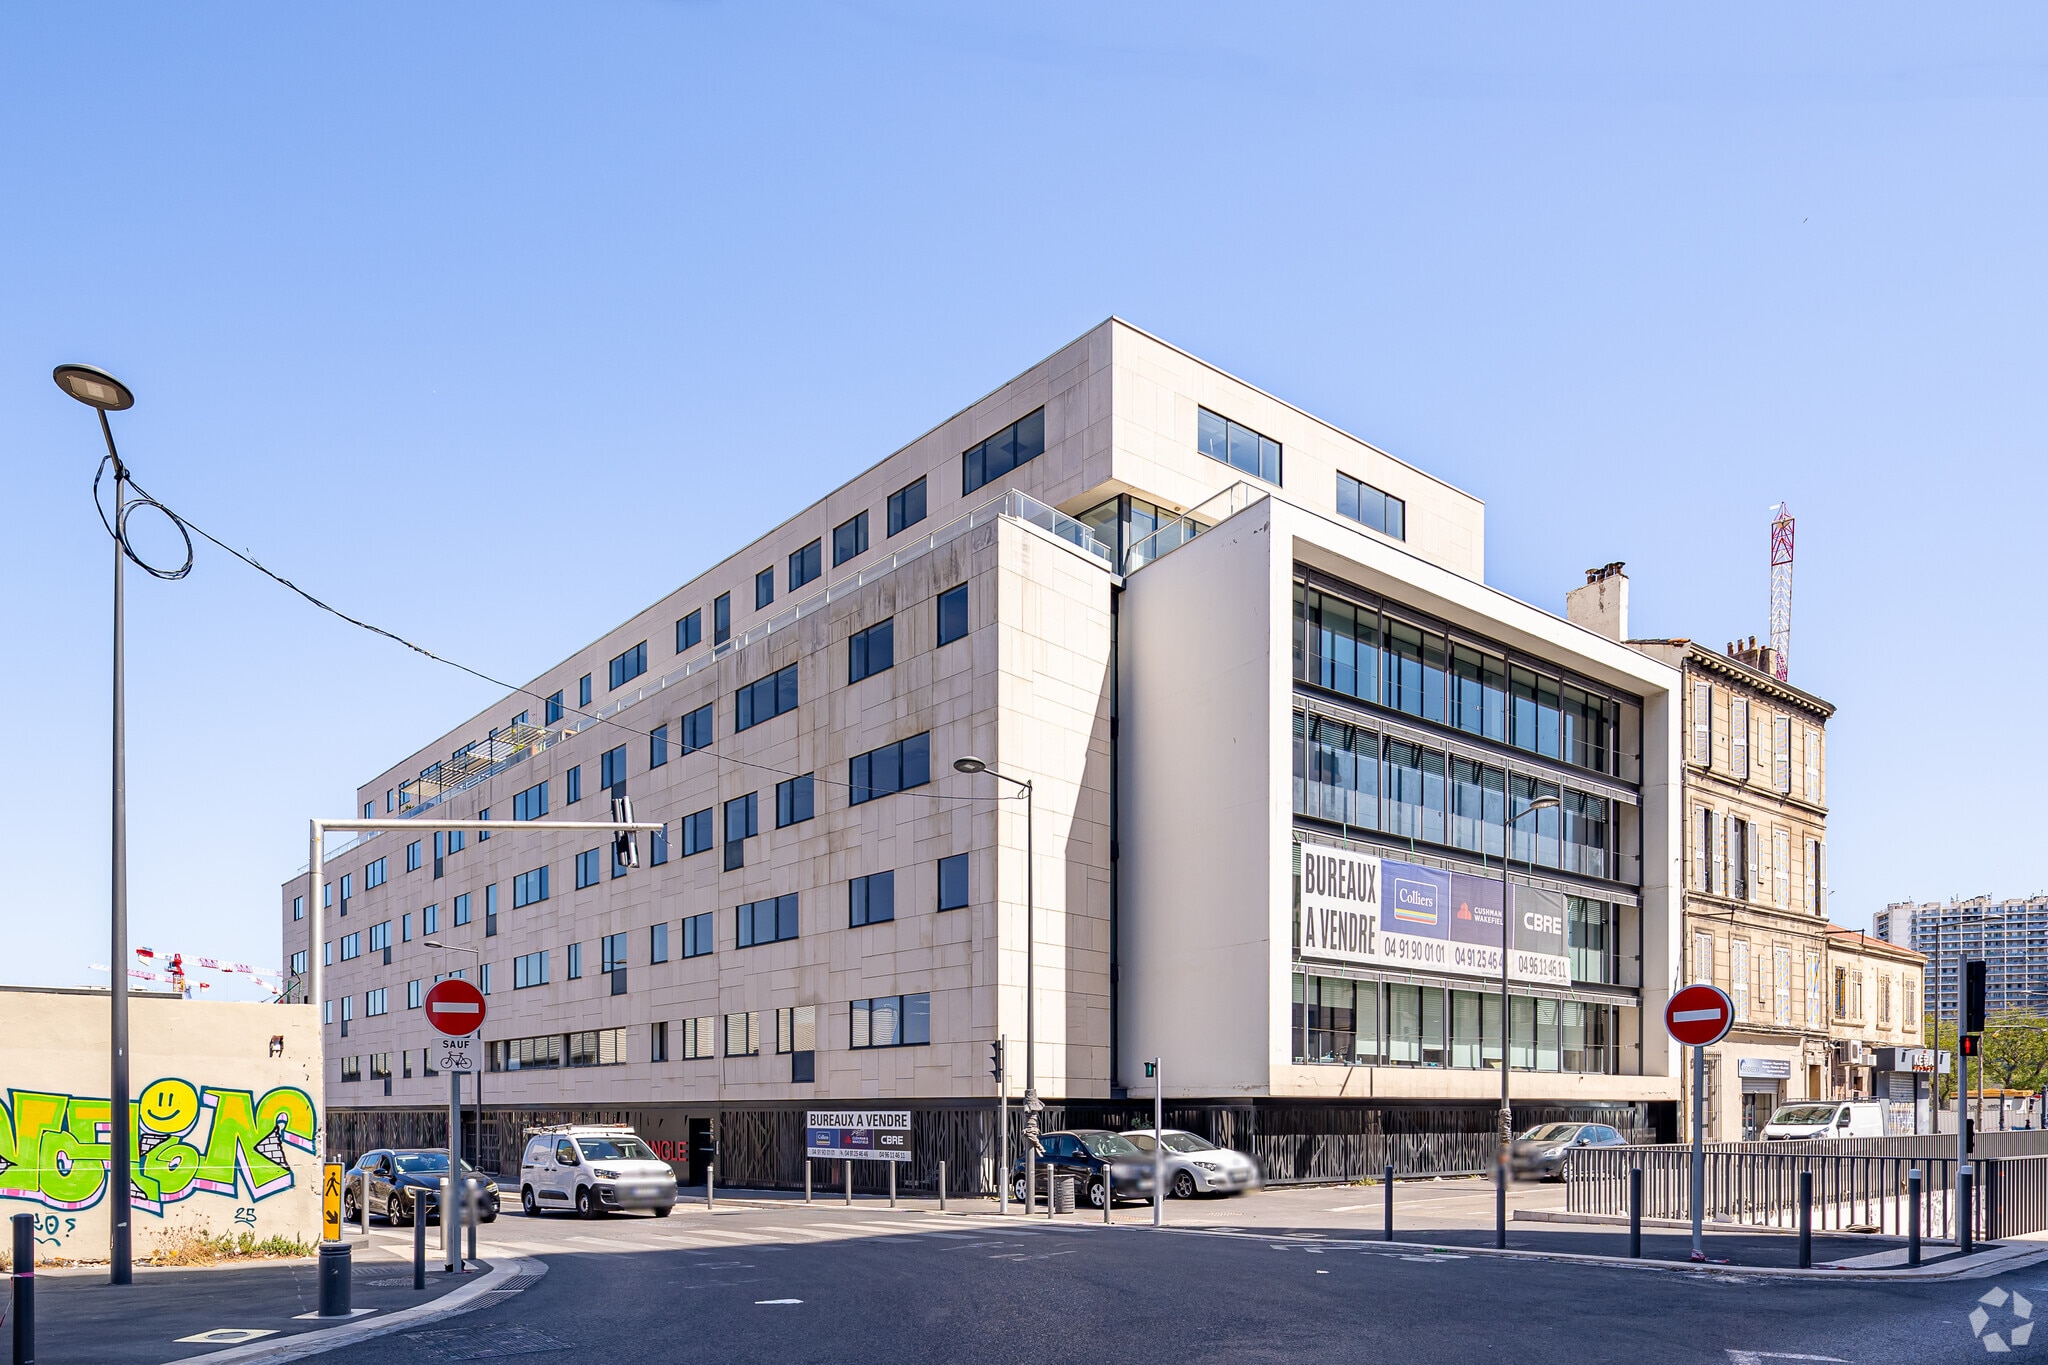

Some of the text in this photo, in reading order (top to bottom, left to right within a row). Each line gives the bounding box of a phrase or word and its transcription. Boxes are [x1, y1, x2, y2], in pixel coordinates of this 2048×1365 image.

[1305, 853, 1376, 904] BUREAUX
[1399, 888, 1433, 907] Colliers
[1474, 906, 1503, 917] CUSHMAN
[1474, 914, 1503, 926] WAKEFIEL
[1306, 906, 1376, 955] A VENDRE
[1523, 912, 1562, 935] CBRE
[1385, 937, 1445, 963] 04 91 90 01 01
[1454, 946, 1465, 965] 04
[1467, 948, 1476, 967] 91
[1477, 949, 1487, 968] 25
[1488, 951, 1498, 969] 46
[1518, 955, 1566, 978] 04 96 11 46 11
[442, 1040, 470, 1048] SAUF
[810, 1113, 908, 1127] BUREAUX A VENDRE
[880, 1135, 904, 1145] CBRE
[234, 1207, 257, 1222] 25
